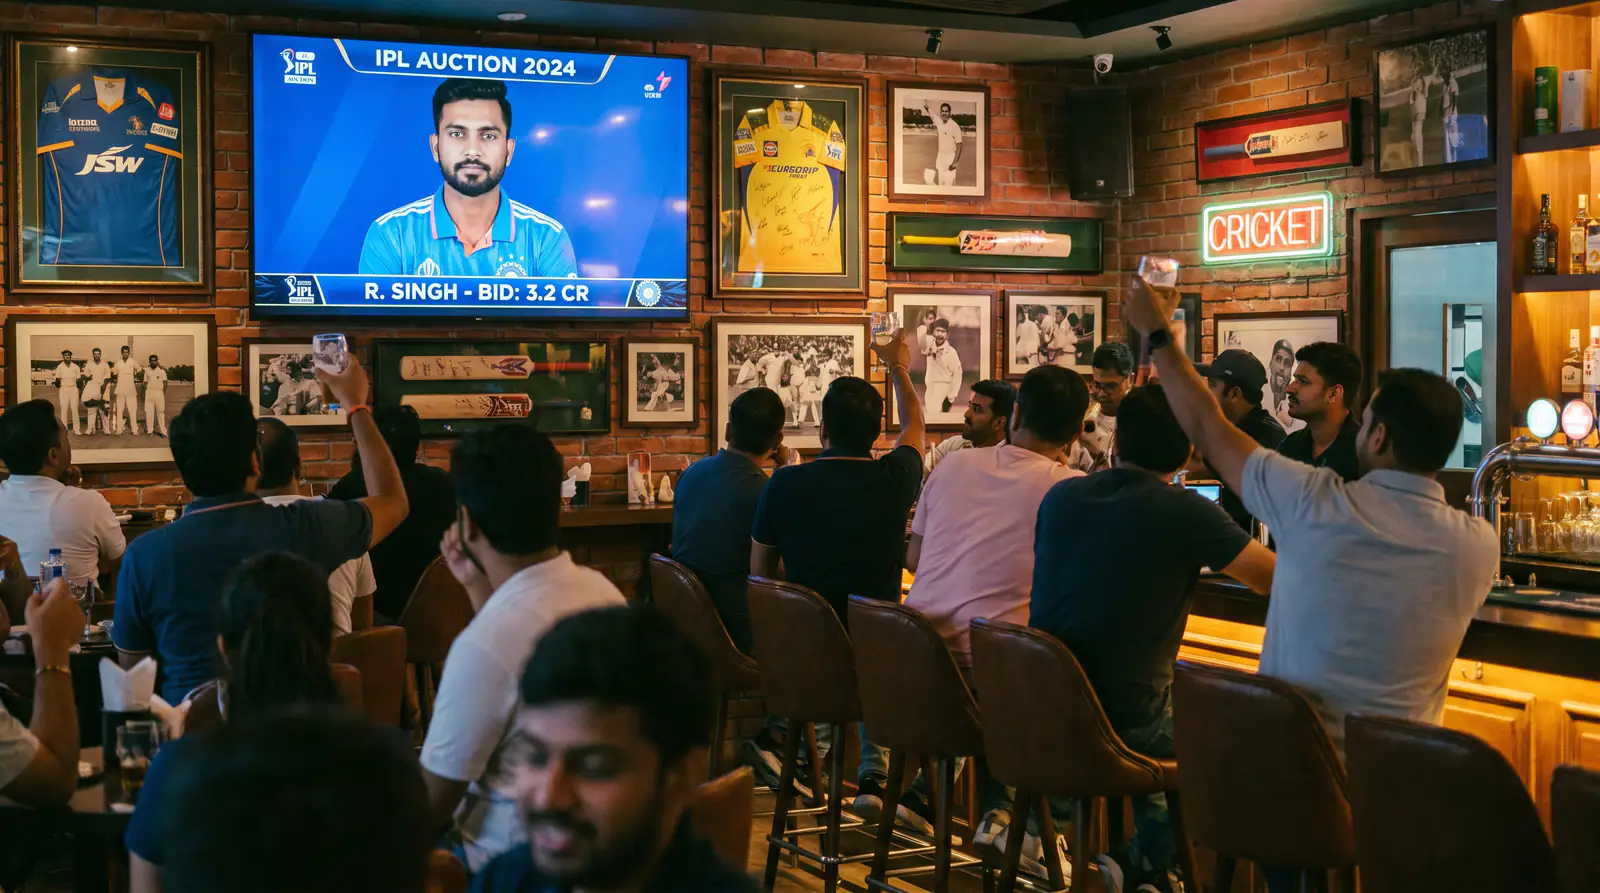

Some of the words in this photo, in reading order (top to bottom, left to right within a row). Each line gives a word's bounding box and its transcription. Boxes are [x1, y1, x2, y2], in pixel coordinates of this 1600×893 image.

[295, 62, 317, 75] IPL
[376, 49, 410, 68] IPL
[416, 51, 517, 74] AUCTION
[523, 57, 577, 77] 2024
[74, 154, 145, 176] JSW
[1208, 206, 1323, 251] CRICKET
[297, 286, 315, 297] IPL
[364, 282, 385, 300] R.
[391, 282, 458, 301] SINGH
[478, 283, 520, 301] BID:
[526, 284, 556, 301] 3.2
[561, 284, 590, 302] CR
